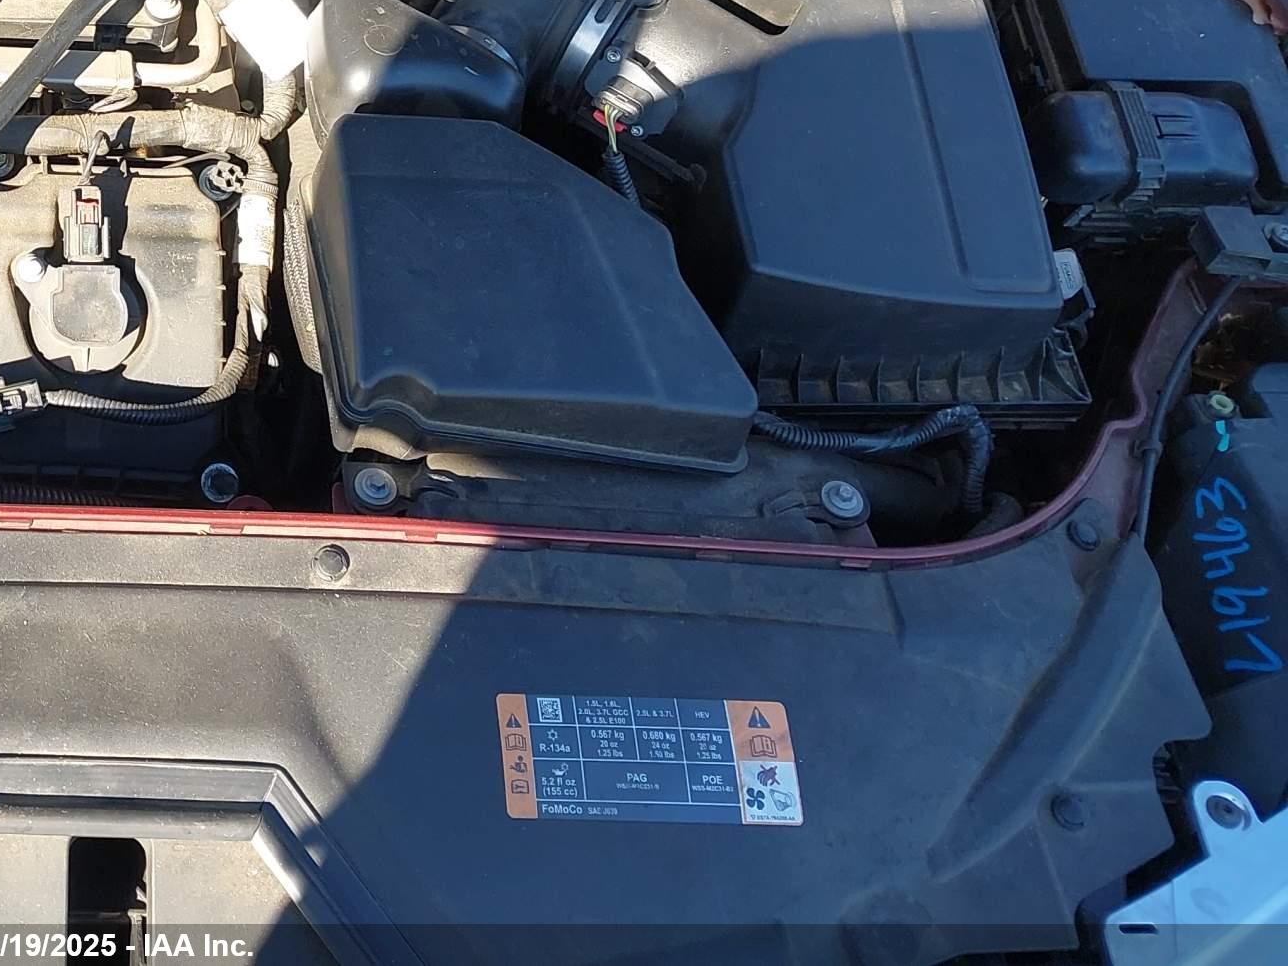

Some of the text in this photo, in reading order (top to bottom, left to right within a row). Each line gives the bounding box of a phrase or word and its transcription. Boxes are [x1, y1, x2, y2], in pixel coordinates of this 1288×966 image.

[1193, 476, 1284, 673] L19463
[694, 711, 710, 719] HEV
[590, 729, 625, 741] 0.567 kg
[642, 731, 676, 743] 0.680 kg
[690, 732, 723, 744] 0.567 kg
[539, 743, 571, 753] R-134a
[541, 777, 555, 786] 5.2
[556, 777, 563, 786] fl
[626, 773, 648, 783] PAG
[702, 775, 724, 785] POE
[542, 787, 578, 797] (155 cc)
[541, 804, 583, 815] FoMoCo
